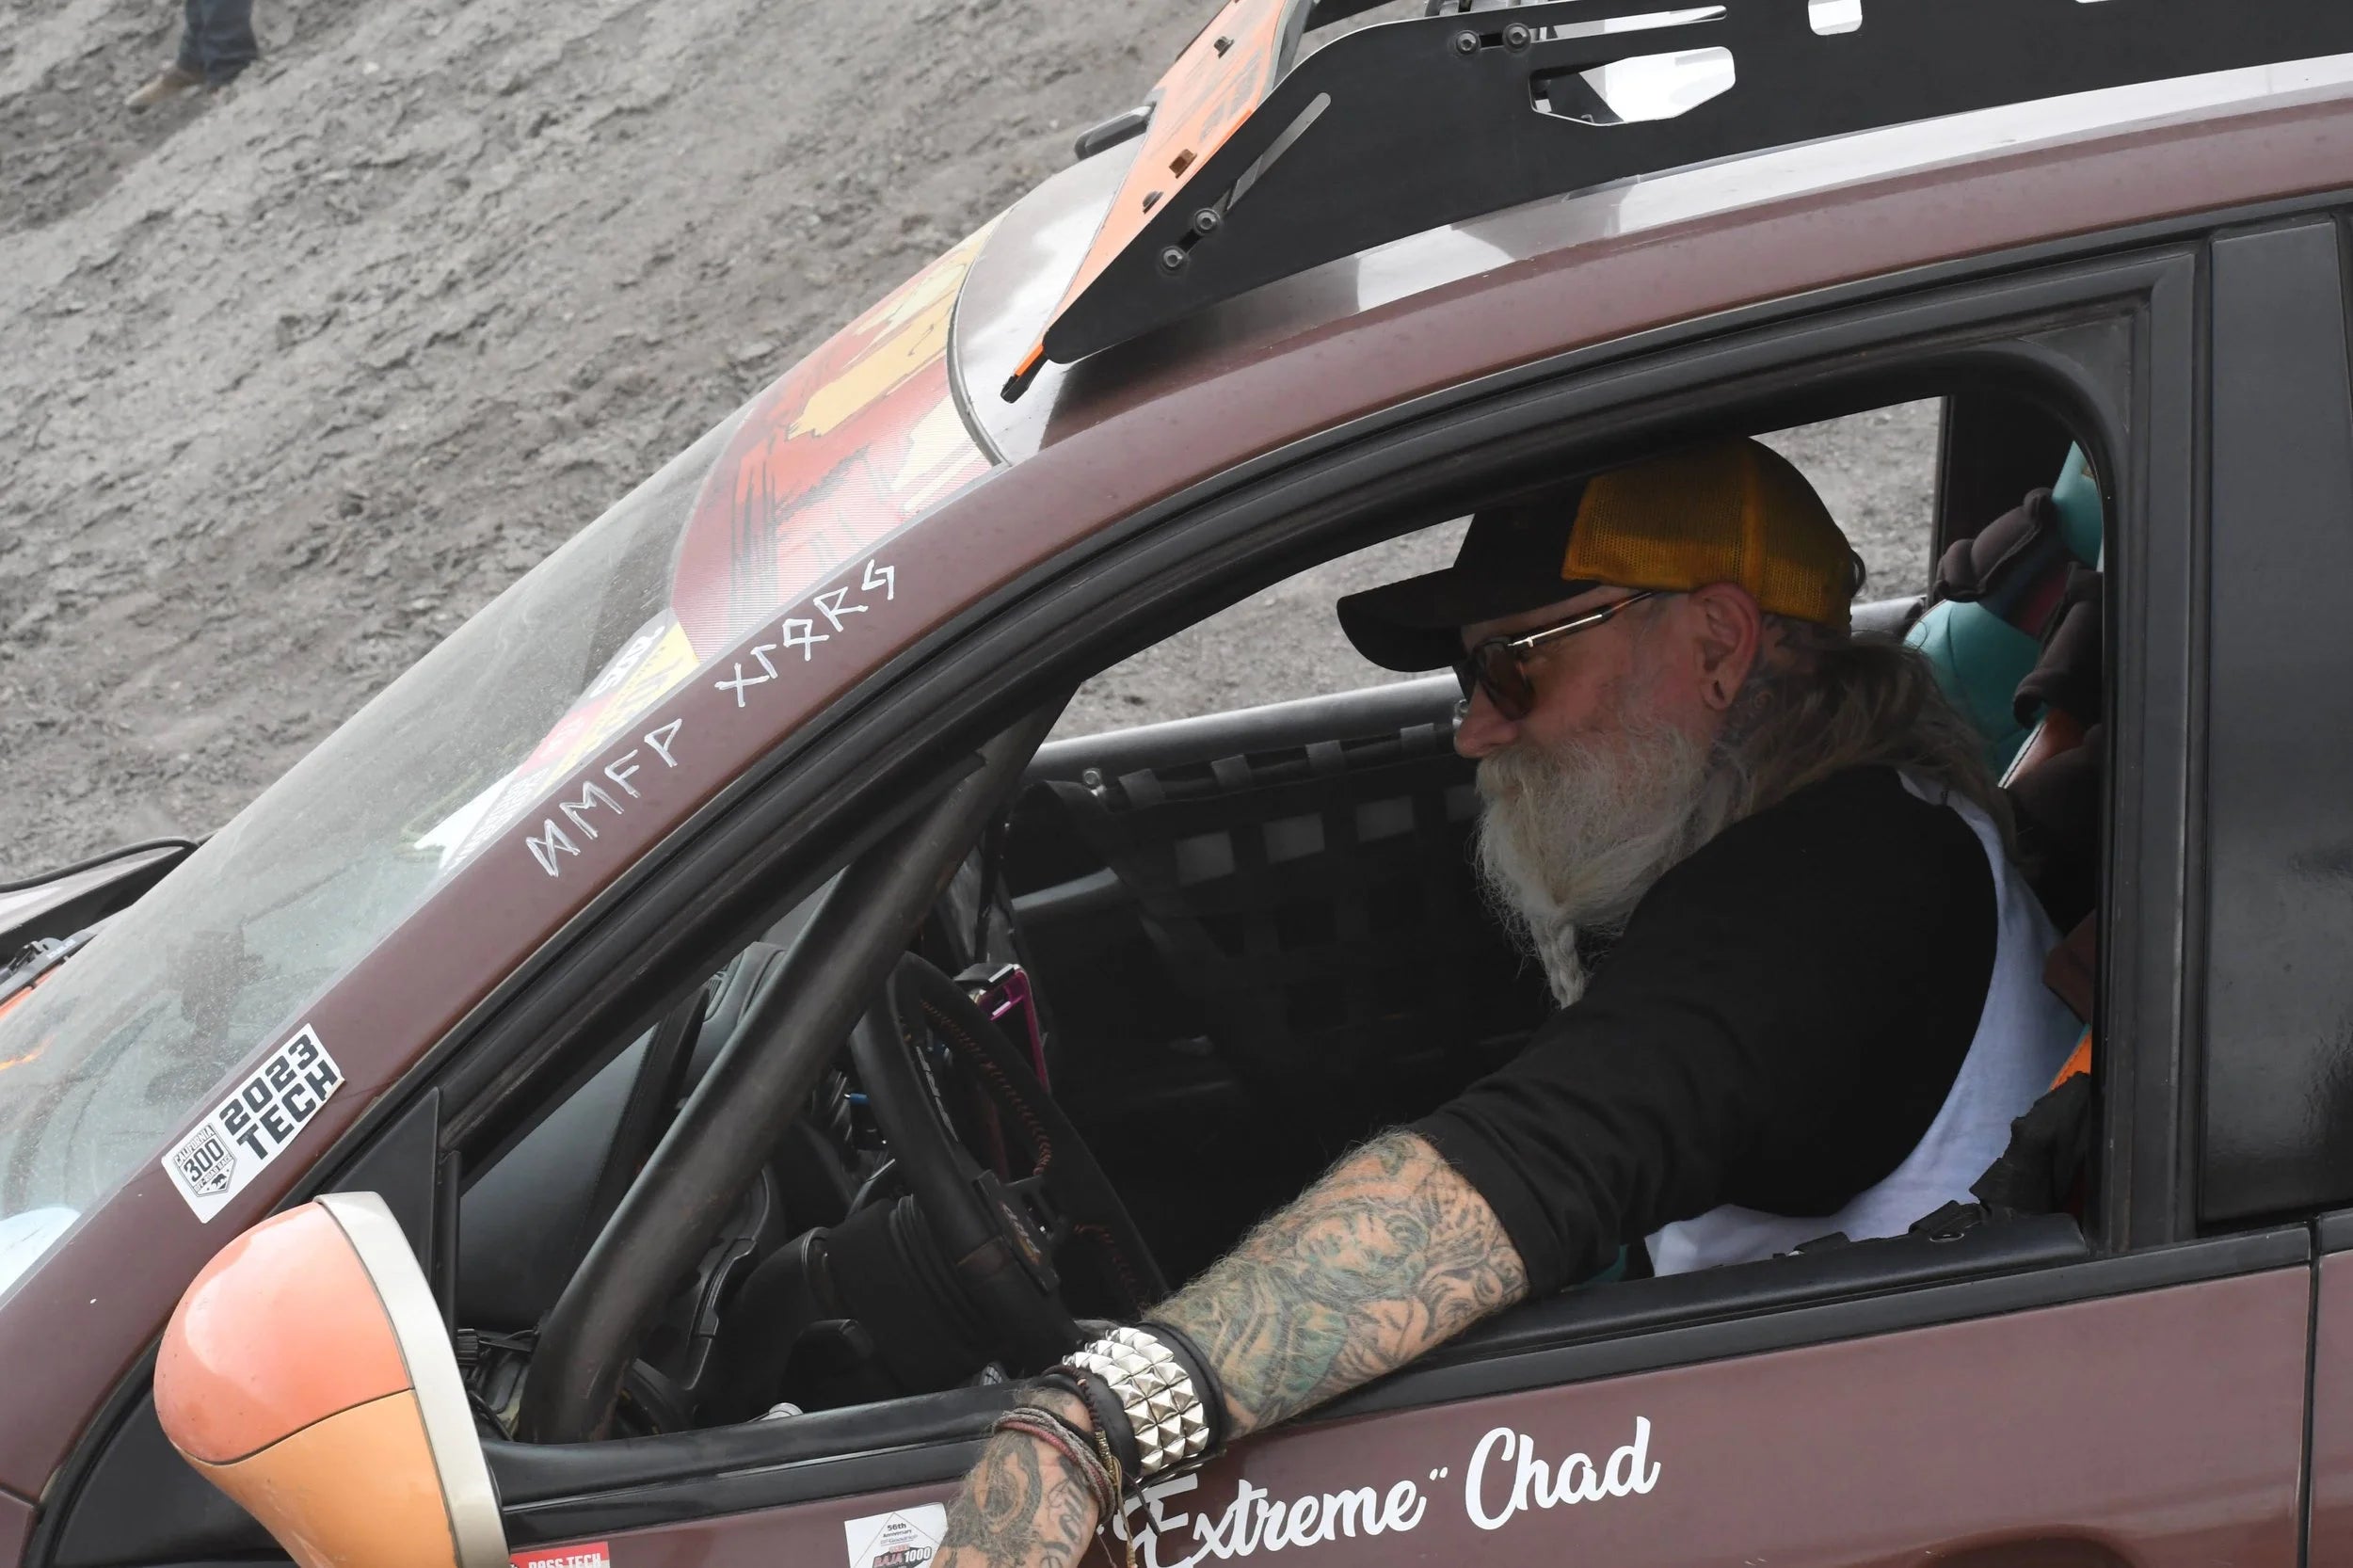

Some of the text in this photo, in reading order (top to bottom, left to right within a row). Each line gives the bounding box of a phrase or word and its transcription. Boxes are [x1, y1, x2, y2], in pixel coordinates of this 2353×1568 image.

[218, 1033, 319, 1136] 2023
[236, 1059, 339, 1160] TECH
[174, 1125, 216, 1165] CALIFORNIA
[184, 1138, 224, 1182] 300
[1465, 1416, 1661, 1530] Chad
[883, 1528, 912, 1538] Anniversary
[887, 1522, 907, 1531] 56th
[904, 1546, 932, 1562] 1000
